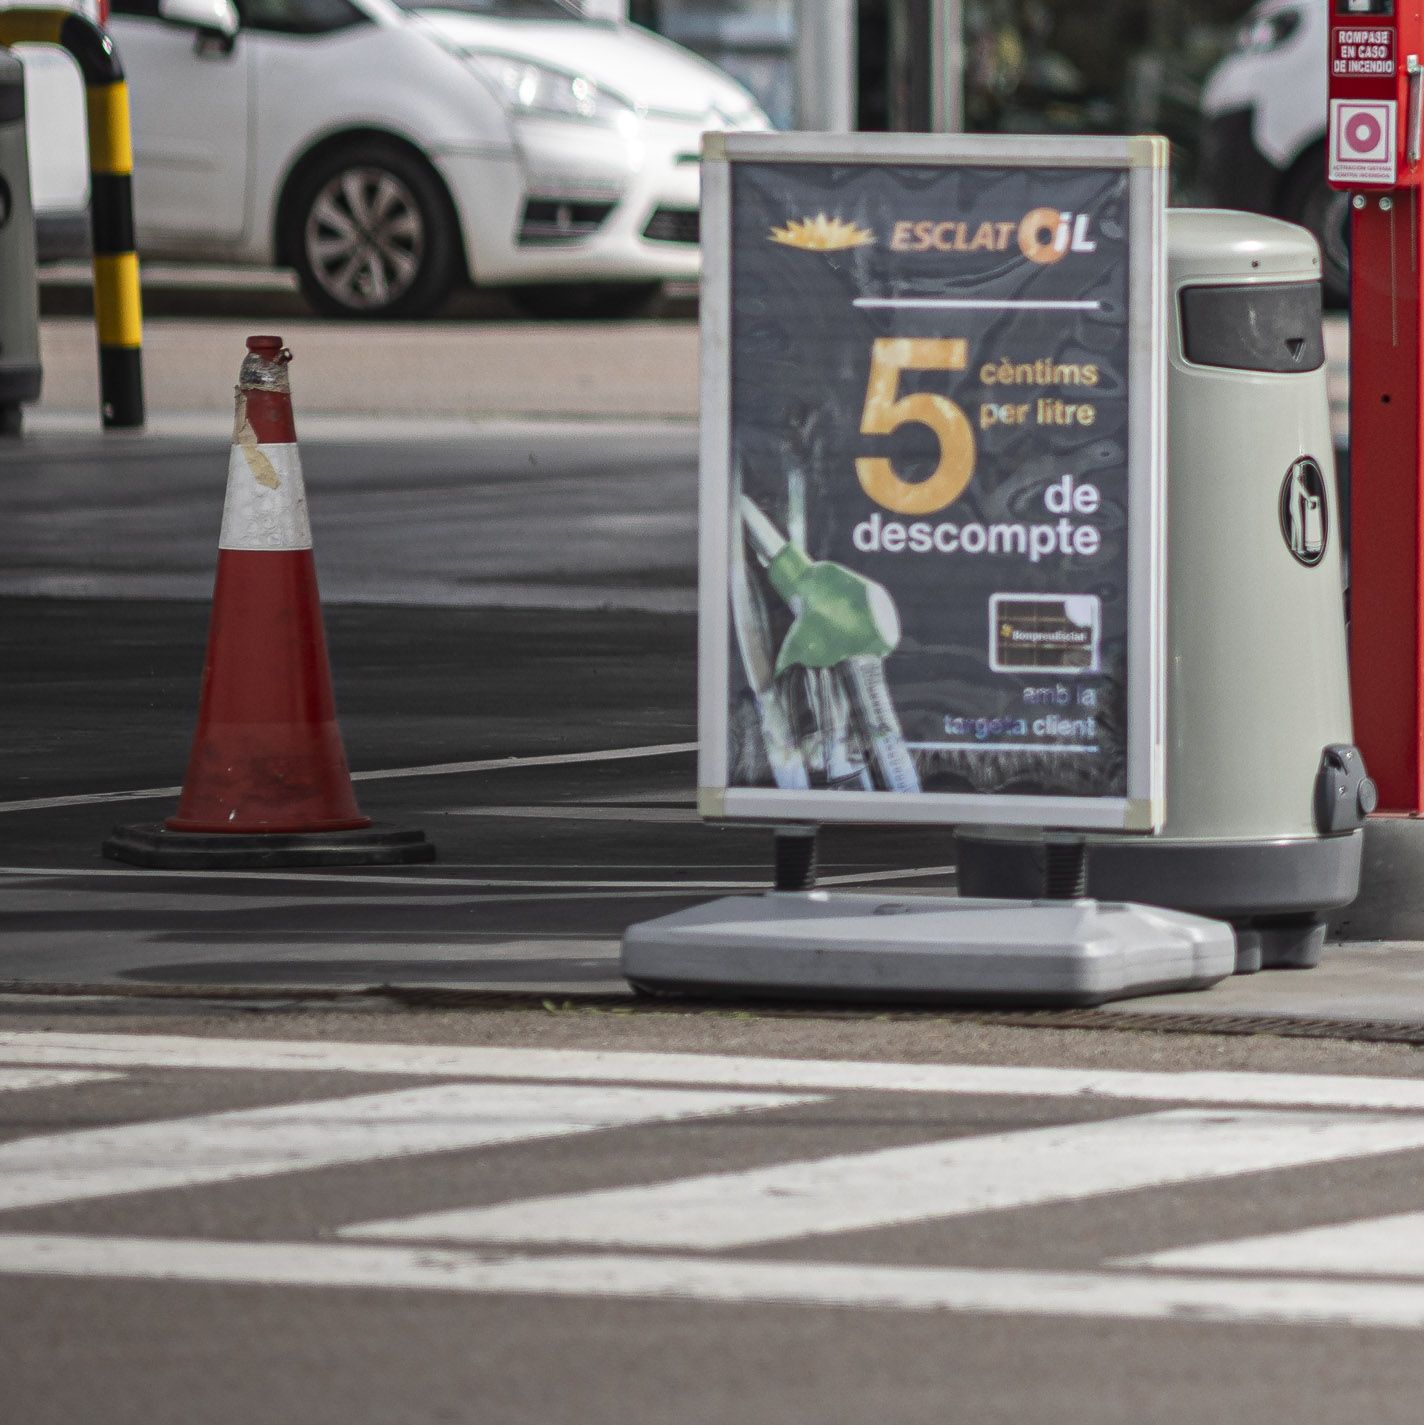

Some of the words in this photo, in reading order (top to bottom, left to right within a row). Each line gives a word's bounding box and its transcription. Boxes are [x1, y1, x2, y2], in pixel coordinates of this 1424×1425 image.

[1339, 31, 1389, 44] ROMPASE
[1341, 45, 1356, 58] EN
[1358, 45, 1388, 58] CASO
[1333, 60, 1346, 73] DE
[1348, 60, 1393, 73] INCENDIO
[855, 336, 976, 516] 5
[980, 357, 1099, 387] cèntims
[980, 402, 1030, 431] per
[1036, 398, 1096, 427] litre
[1044, 474, 1100, 514] de
[852, 512, 1100, 563] descompte
[1032, 714, 1097, 737] client
